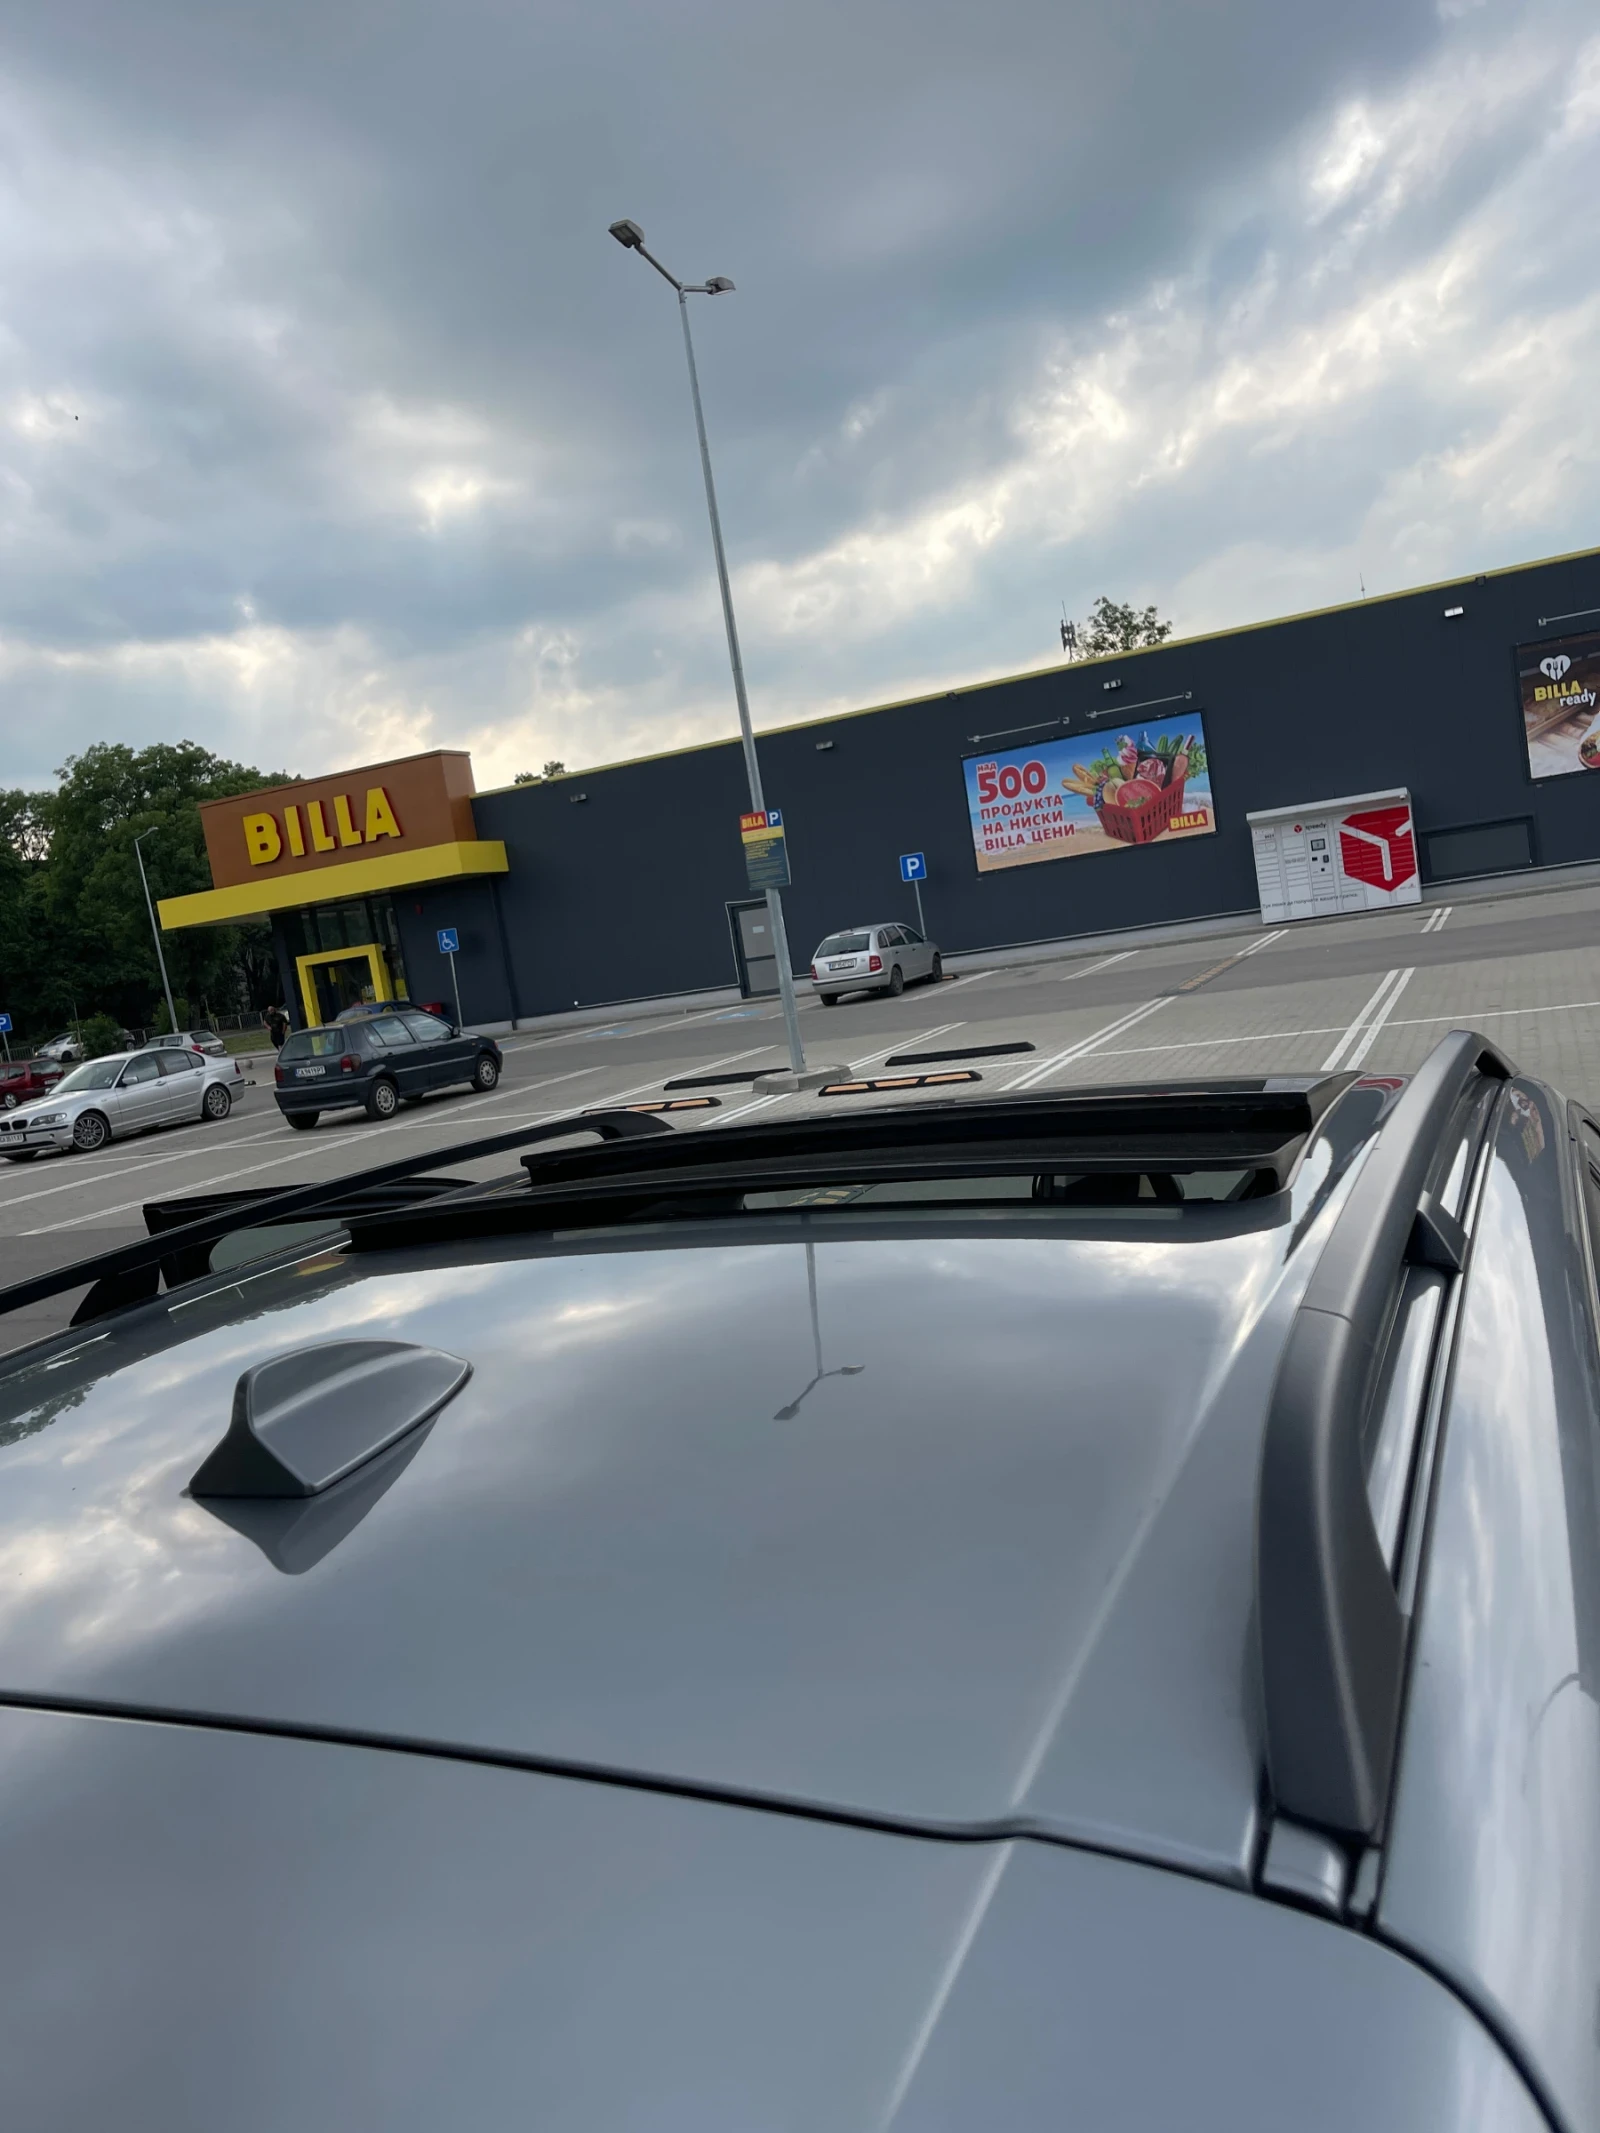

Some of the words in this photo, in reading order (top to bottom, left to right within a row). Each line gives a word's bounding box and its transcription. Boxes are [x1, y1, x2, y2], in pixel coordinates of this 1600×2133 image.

[1534, 680, 1582, 702] BILLA
[1560, 688, 1596, 707] ready
[978, 761, 1046, 804] 500
[981, 795, 1063, 820] ПРОДУКТА
[242, 787, 402, 866] BILLA
[741, 815, 765, 829] BILLA
[769, 812, 779, 825] P
[983, 822, 1004, 836] НА
[1009, 810, 1063, 831] НИСКИ
[1170, 813, 1206, 830] BILLA
[985, 833, 1025, 851] BILLA
[1031, 824, 1075, 843] ЦЕНИ
[906, 857, 920, 877] P
